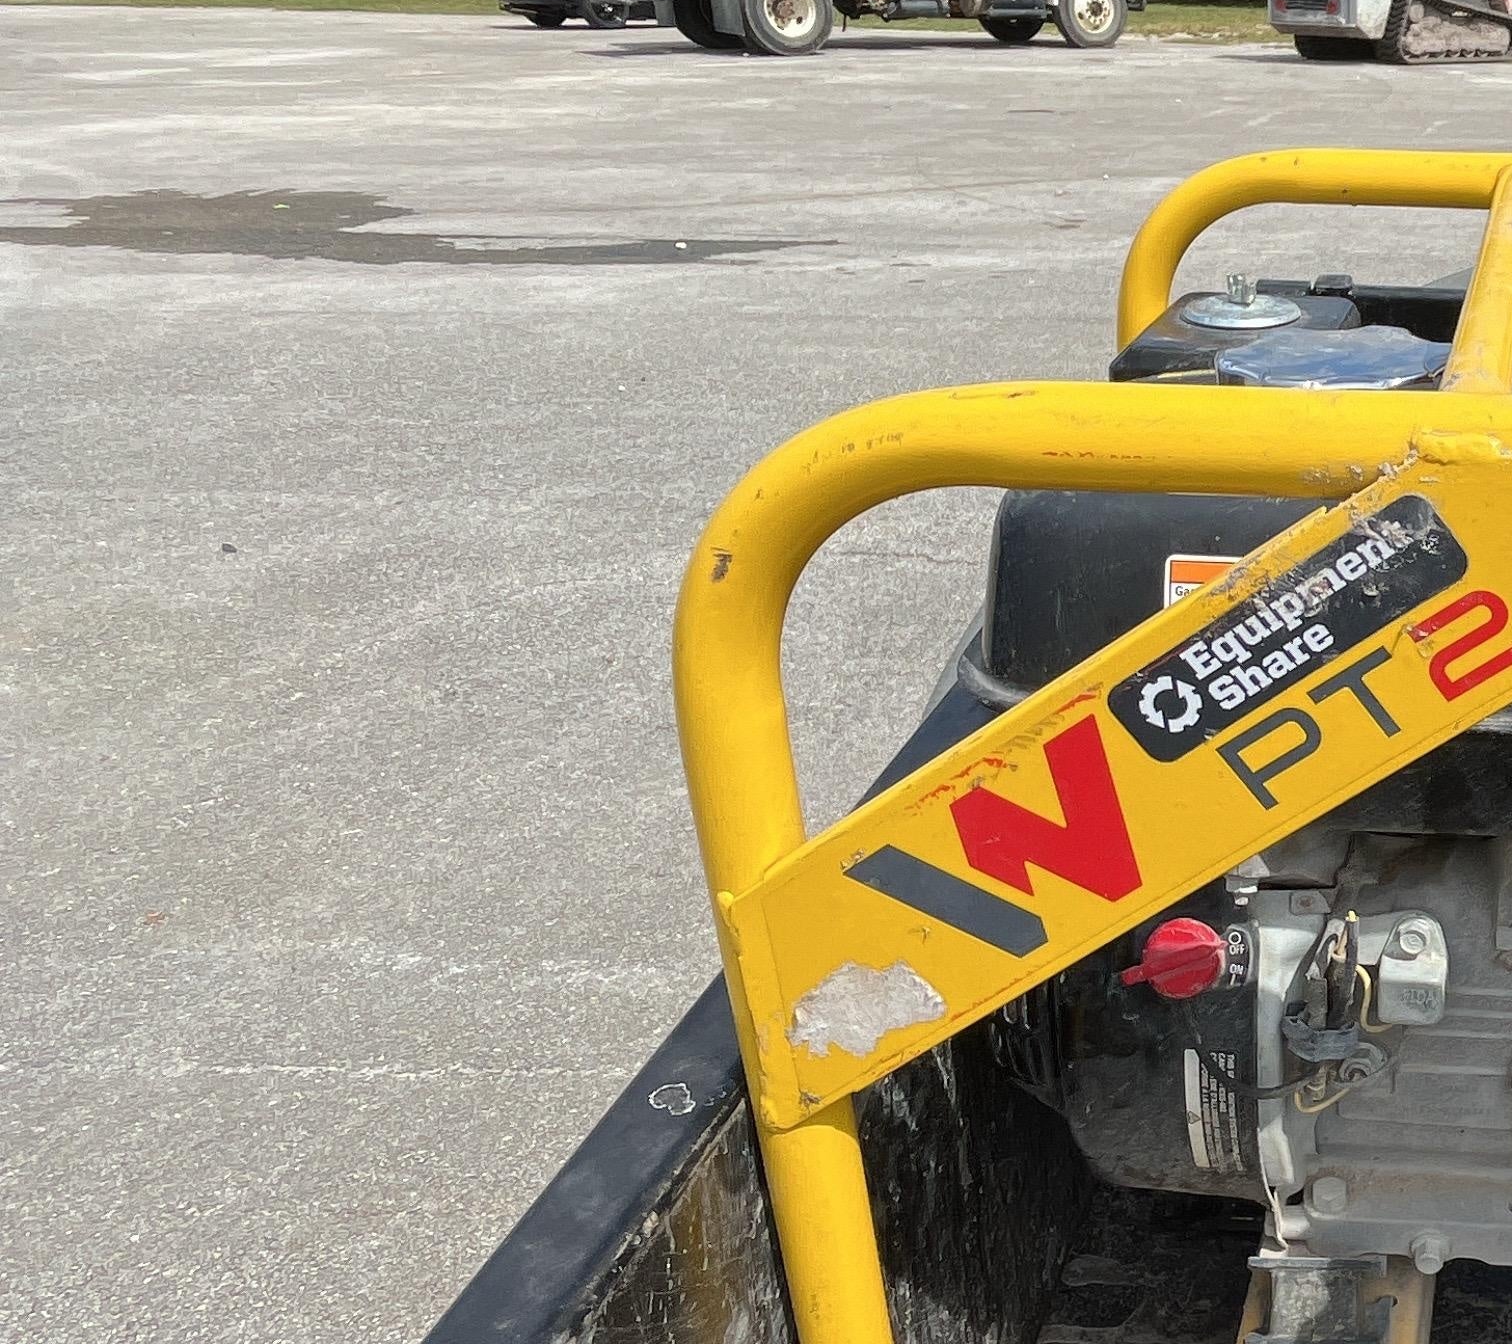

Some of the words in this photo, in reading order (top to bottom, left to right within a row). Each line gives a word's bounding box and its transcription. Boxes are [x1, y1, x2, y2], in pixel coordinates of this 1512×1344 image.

[1179, 522, 1410, 680] Equipmen
[1208, 622, 1335, 710] Share
[1229, 944, 1245, 955] OFF
[1229, 963, 1244, 975] ON
